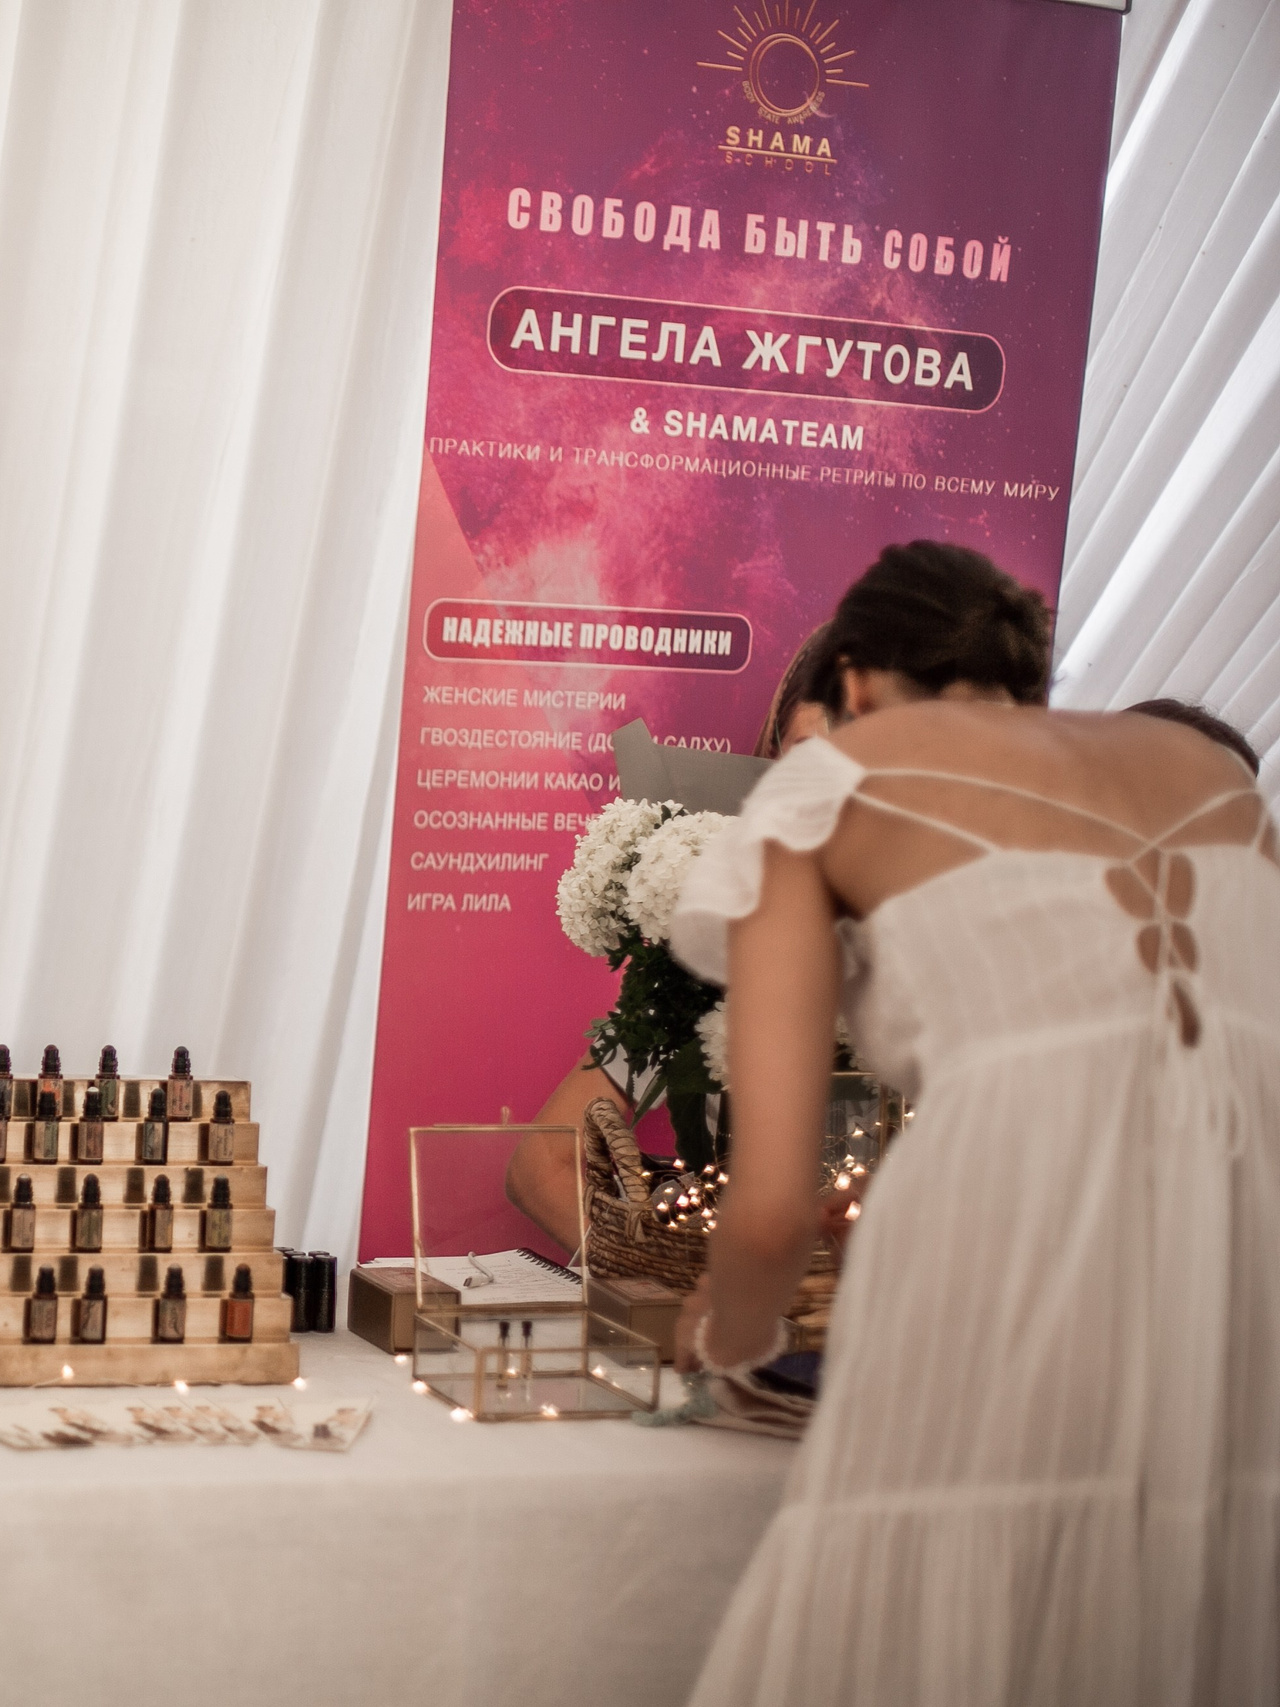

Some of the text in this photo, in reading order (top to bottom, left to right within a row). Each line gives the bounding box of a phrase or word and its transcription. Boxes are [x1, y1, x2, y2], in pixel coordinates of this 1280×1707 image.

[725, 125, 832, 158] SHAMA
[725, 151, 831, 176] SCHOOL
[507, 187, 1012, 283] СВОБОДА БЫТЬ СОБОЙ
[510, 308, 975, 392] АНГЕЛА ЖГУТОВА
[630, 406, 865, 451] & SHAMATEAM
[429, 437, 1061, 502] ПРАКТИКИ И ТРАНСФОРМАЦИОННЫЕ РЕТРИТЫ ПО ВСЕМУ МИРУ
[442, 616, 732, 657] НАДЕЖНЫЕ ПРОВОДНИКИ
[423, 685, 626, 711] ЖЕНСКИЕ МИСТЕРИИ
[420, 726, 583, 751] ГВОЗДЕСТОЯНИЕ
[417, 768, 539, 792] ЦЕРЕМОНИИ
[543, 771, 604, 792] КАКАО
[413, 809, 549, 832] ОСОЗНАННЫЕ
[410, 851, 549, 874] САУНДХИЛИНГ
[407, 893, 512, 912] ИГРА ЛИЛА
